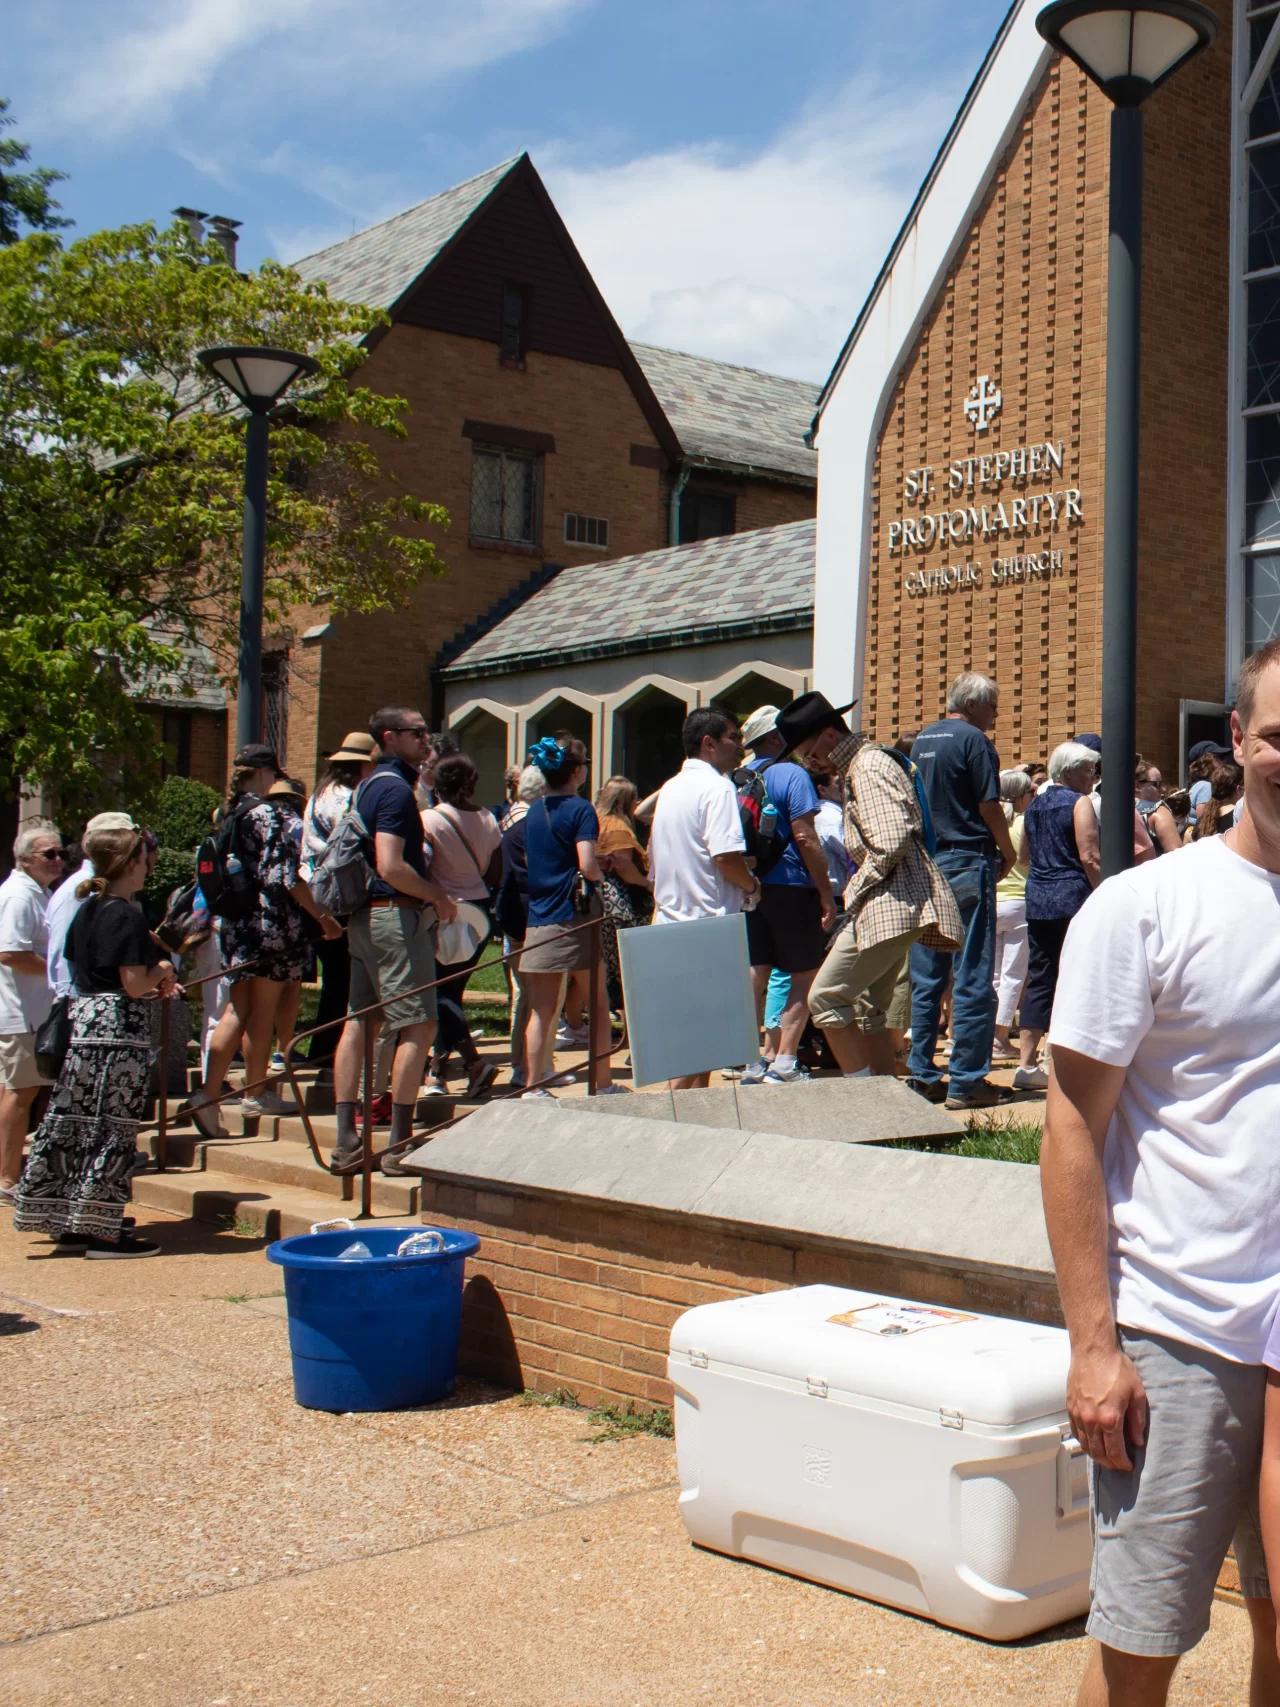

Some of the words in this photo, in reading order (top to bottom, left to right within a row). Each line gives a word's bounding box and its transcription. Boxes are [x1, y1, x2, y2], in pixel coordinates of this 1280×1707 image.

[904, 467, 936, 499] ST.
[949, 440, 1064, 490] STEPHEN
[888, 489, 1083, 549] PROTOMARTYR
[905, 561, 982, 591] CATHOLIC
[991, 549, 1063, 578] CHURCH
